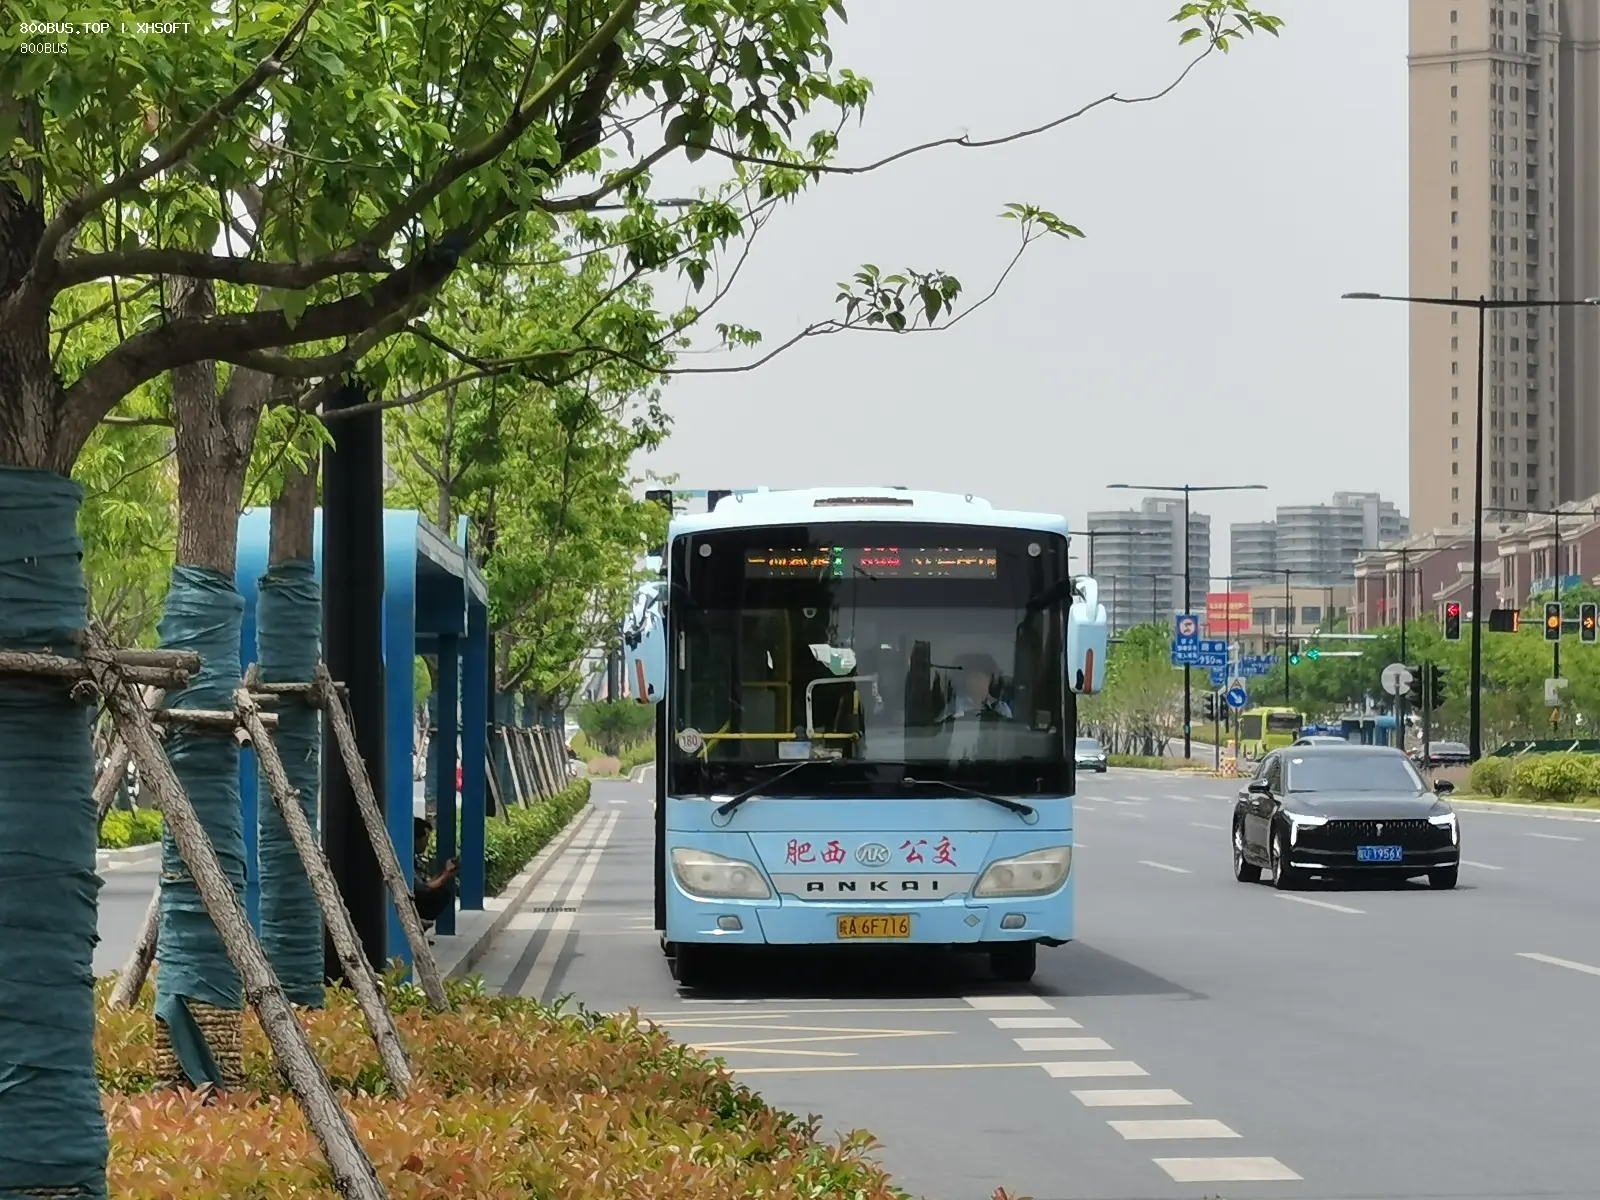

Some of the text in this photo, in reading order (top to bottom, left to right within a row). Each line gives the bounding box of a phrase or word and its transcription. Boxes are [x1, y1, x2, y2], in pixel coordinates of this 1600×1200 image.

[682, 735, 698, 747] 180
[785, 838, 847, 866] 肥西
[898, 835, 957, 867] 公交
[806, 880, 939, 892] ANKAI
